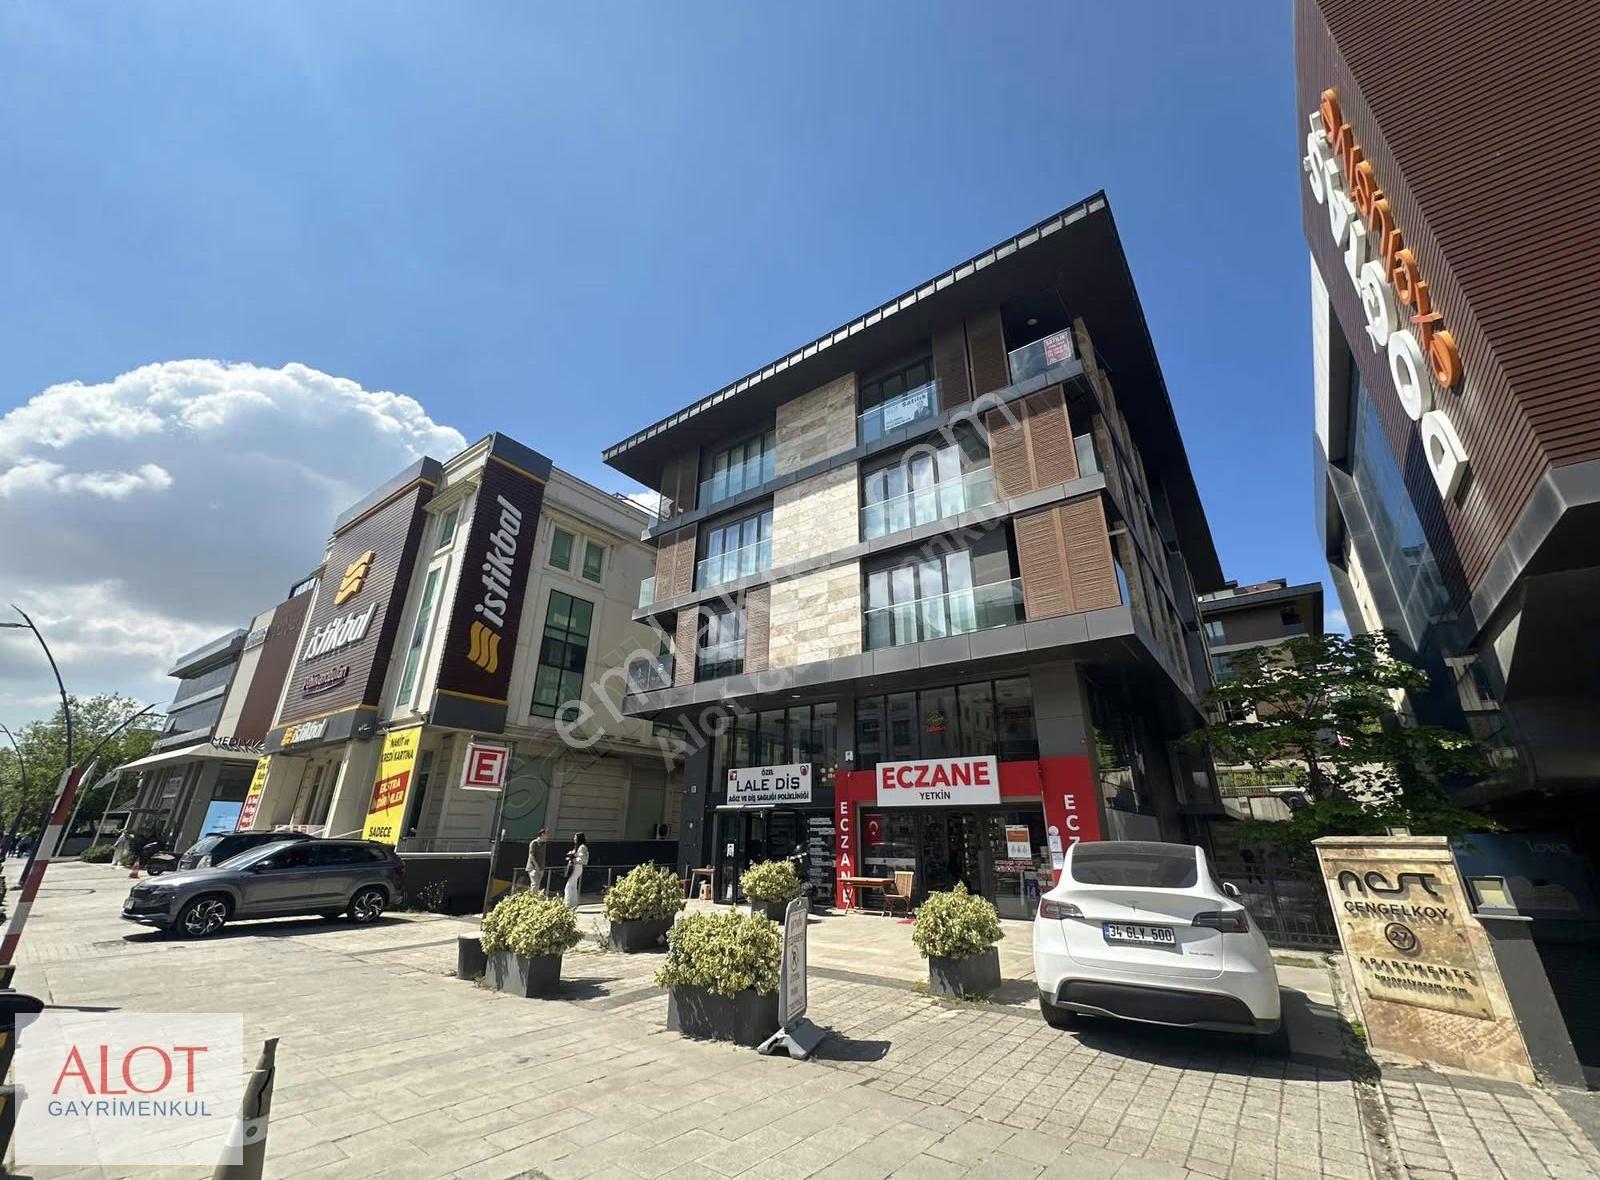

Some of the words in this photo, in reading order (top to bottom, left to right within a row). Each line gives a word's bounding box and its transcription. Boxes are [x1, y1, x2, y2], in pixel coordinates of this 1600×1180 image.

[474, 494, 523, 628] istikbal
[303, 601, 379, 661] istikbal
[475, 753, 498, 781] E
[882, 761, 990, 789] ECZANE
[737, 779, 769, 792] LALE
[775, 773, 800, 790] DİŞ
[919, 790, 951, 800] YETKİN
[368, 826, 392, 838] SADECE
[1110, 925, 1123, 938] 34
[1126, 927, 1146, 939] GLY
[1151, 928, 1172, 941] 500
[1359, 956, 1473, 980] APARTMENTS
